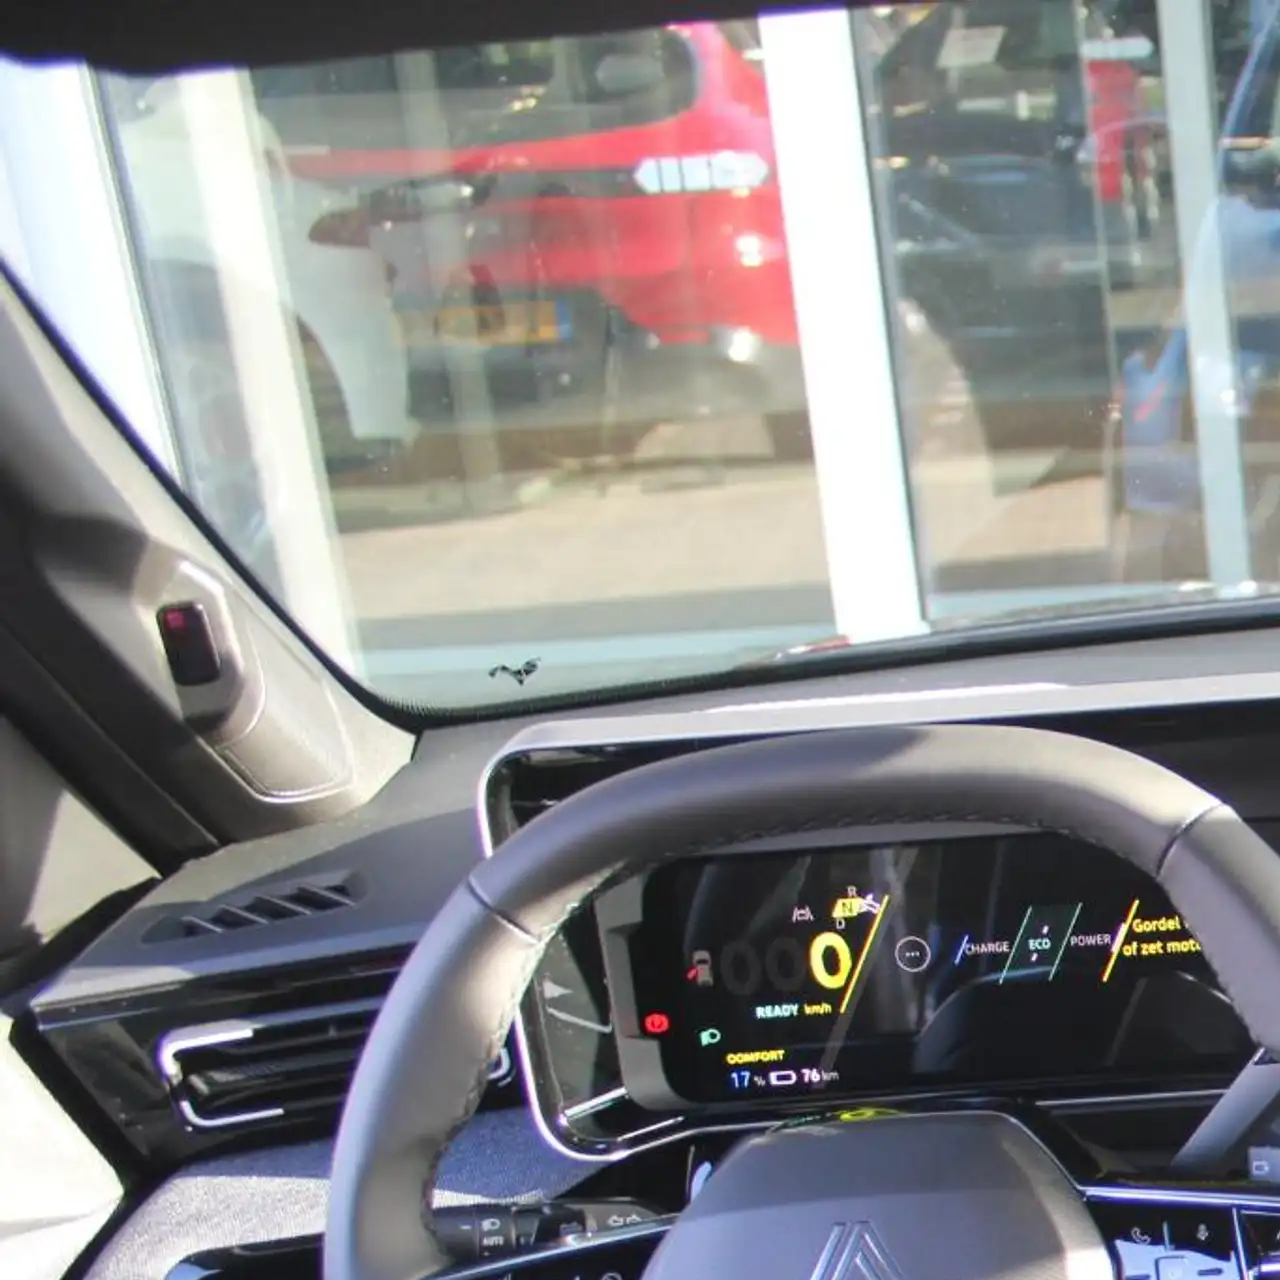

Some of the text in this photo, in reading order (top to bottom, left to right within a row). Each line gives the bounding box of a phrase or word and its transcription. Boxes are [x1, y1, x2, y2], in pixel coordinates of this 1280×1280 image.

[1132, 915, 1181, 934] Gordel
[1028, 938, 1051, 951] ECO
[1070, 933, 1112, 947] POWER
[965, 940, 1010, 956] CHARGE
[1122, 942, 1139, 957] of
[1140, 941, 1163, 955] zet
[755, 1002, 799, 1019] READY
[804, 1001, 833, 1016] km/h
[726, 1050, 786, 1065] COMFORT
[730, 1071, 751, 1089] 17
[800, 1068, 840, 1083] 76 km
